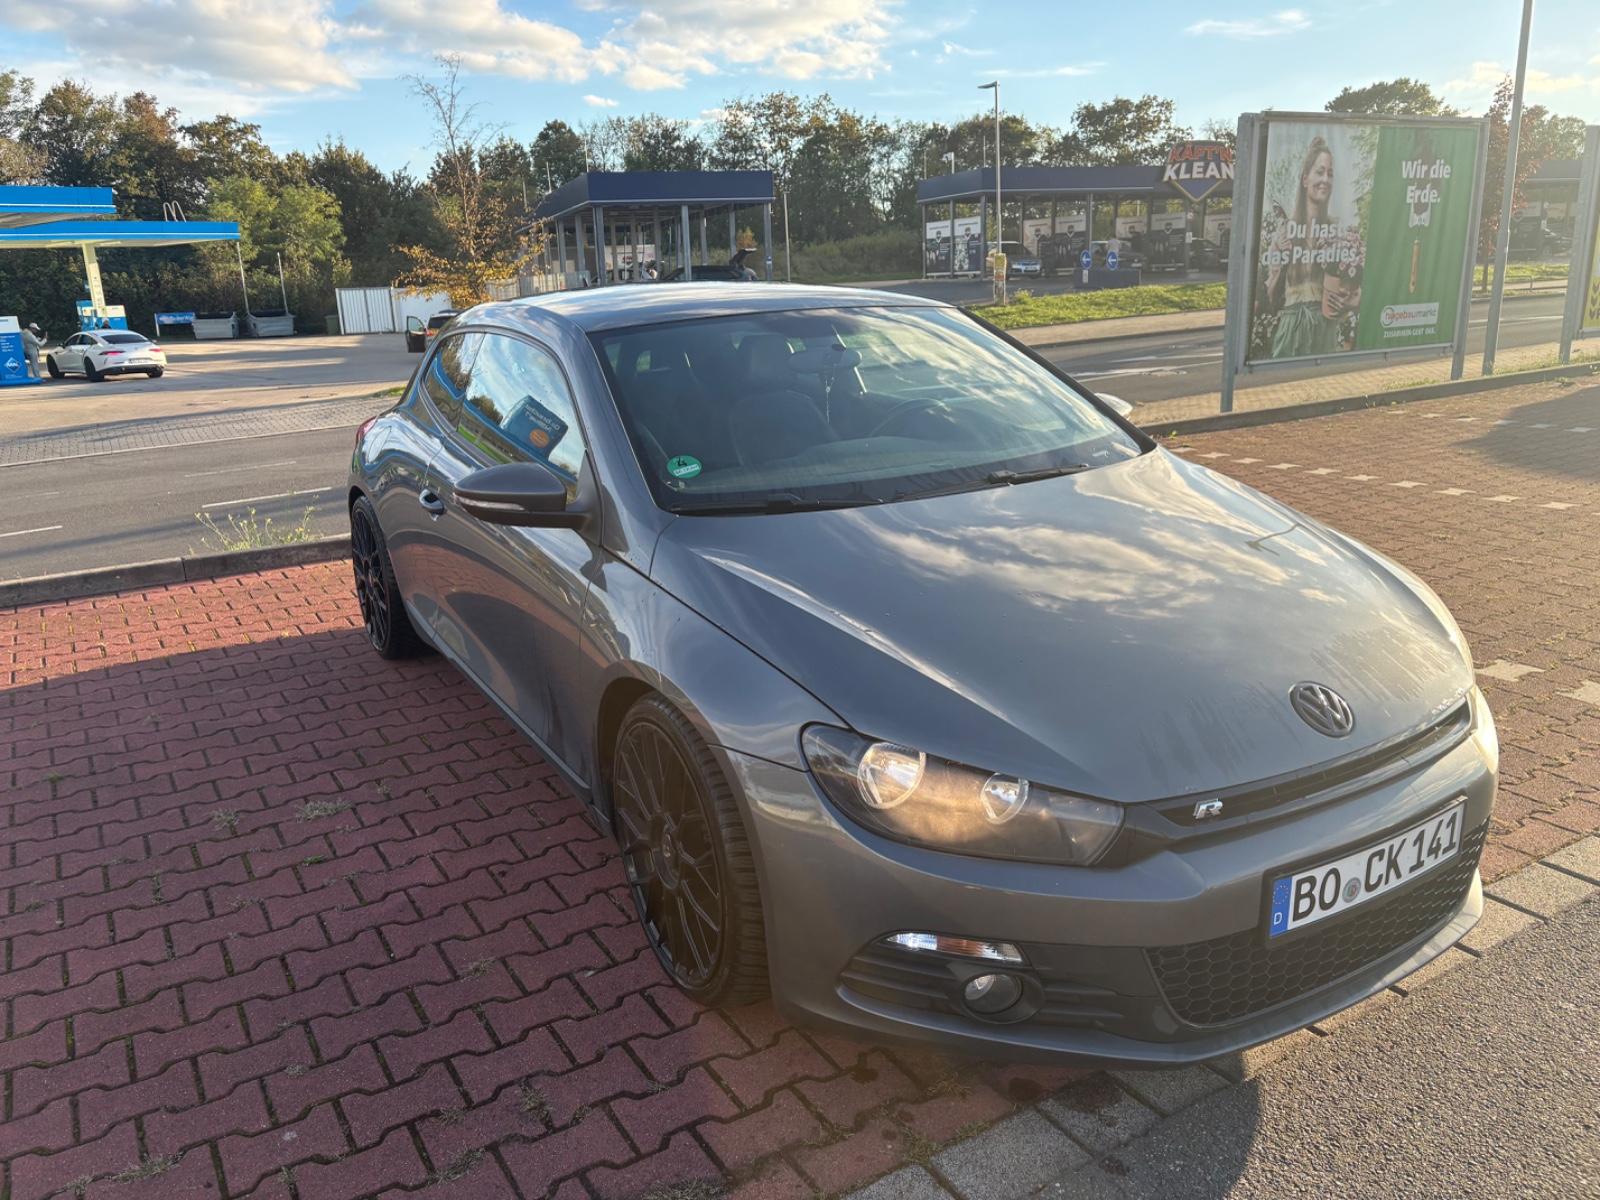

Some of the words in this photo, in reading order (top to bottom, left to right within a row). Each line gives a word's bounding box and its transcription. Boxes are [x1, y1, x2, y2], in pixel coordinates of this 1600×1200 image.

[1162, 161, 1235, 182] KLEAN
[1402, 160, 1428, 179] Wir
[1430, 159, 1451, 178] die
[1406, 183, 1441, 203] Erde.
[1286, 220, 1306, 239] Du
[1311, 218, 1345, 239] hast
[1261, 248, 1290, 265] das
[1292, 244, 1359, 265] Paradies.
[1292, 867, 1341, 922] BO
[1364, 838, 1407, 893] CK
[1409, 811, 1458, 873] 141
[1273, 912, 1283, 926] D
